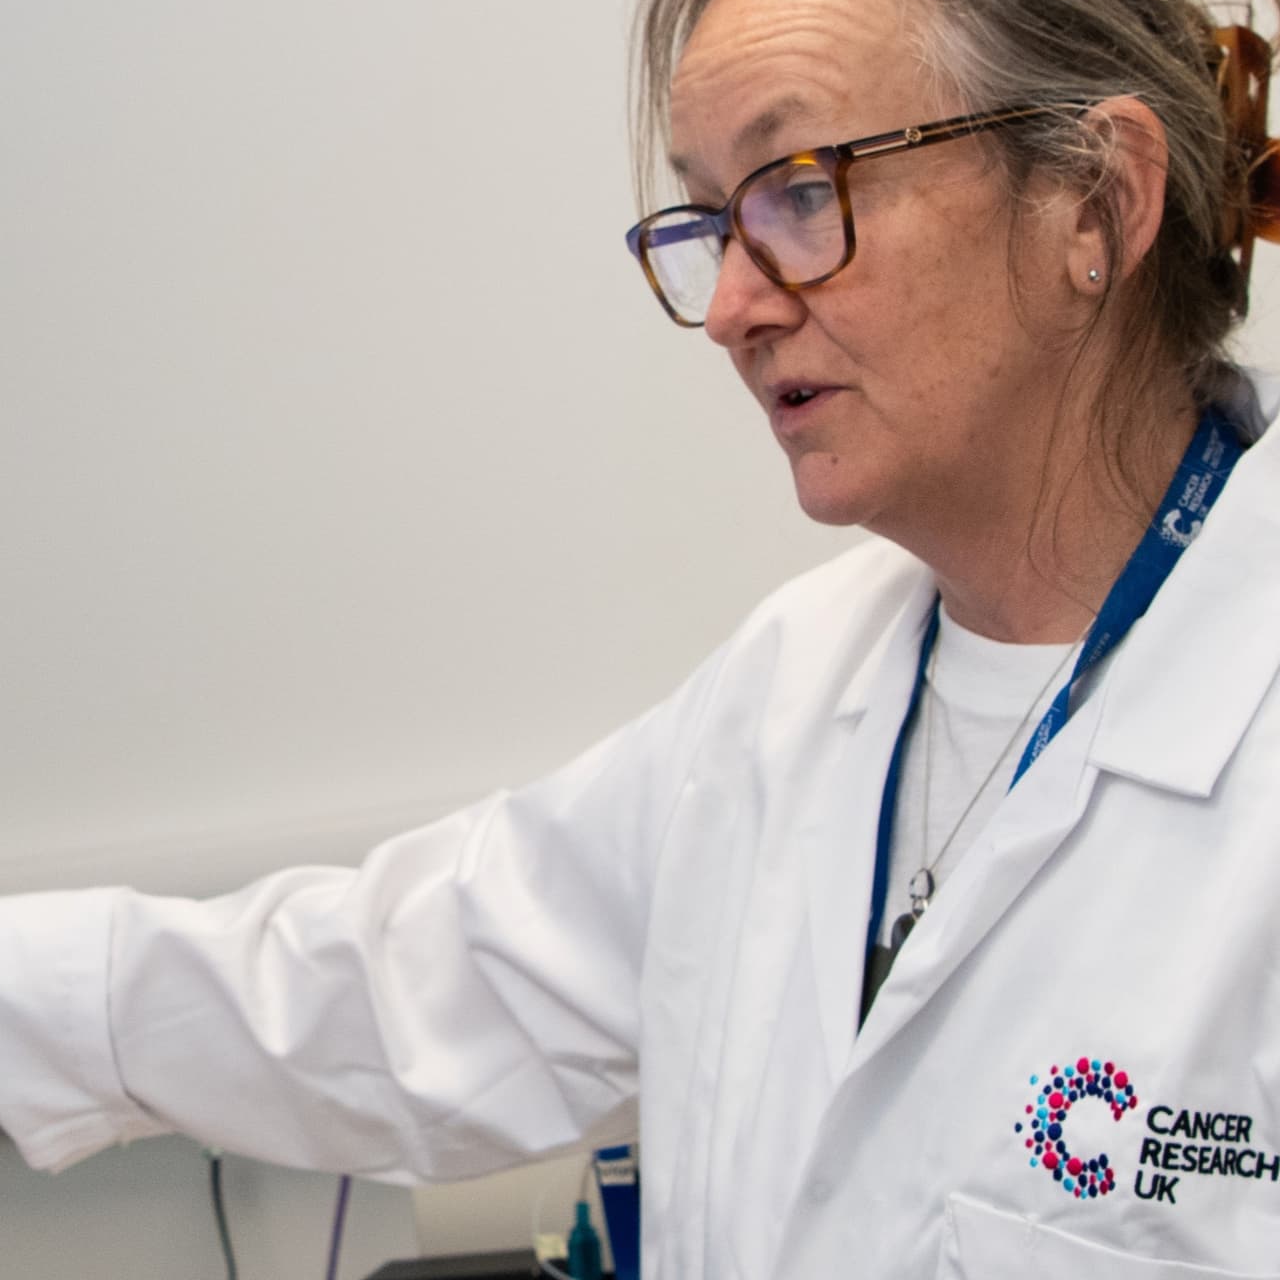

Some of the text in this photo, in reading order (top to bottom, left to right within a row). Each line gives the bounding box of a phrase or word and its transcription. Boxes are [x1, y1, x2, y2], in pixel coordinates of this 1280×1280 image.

[1147, 1105, 1253, 1143] CANCER
[1139, 1137, 1280, 1182] RESEARCH
[1134, 1170, 1180, 1204] UK
